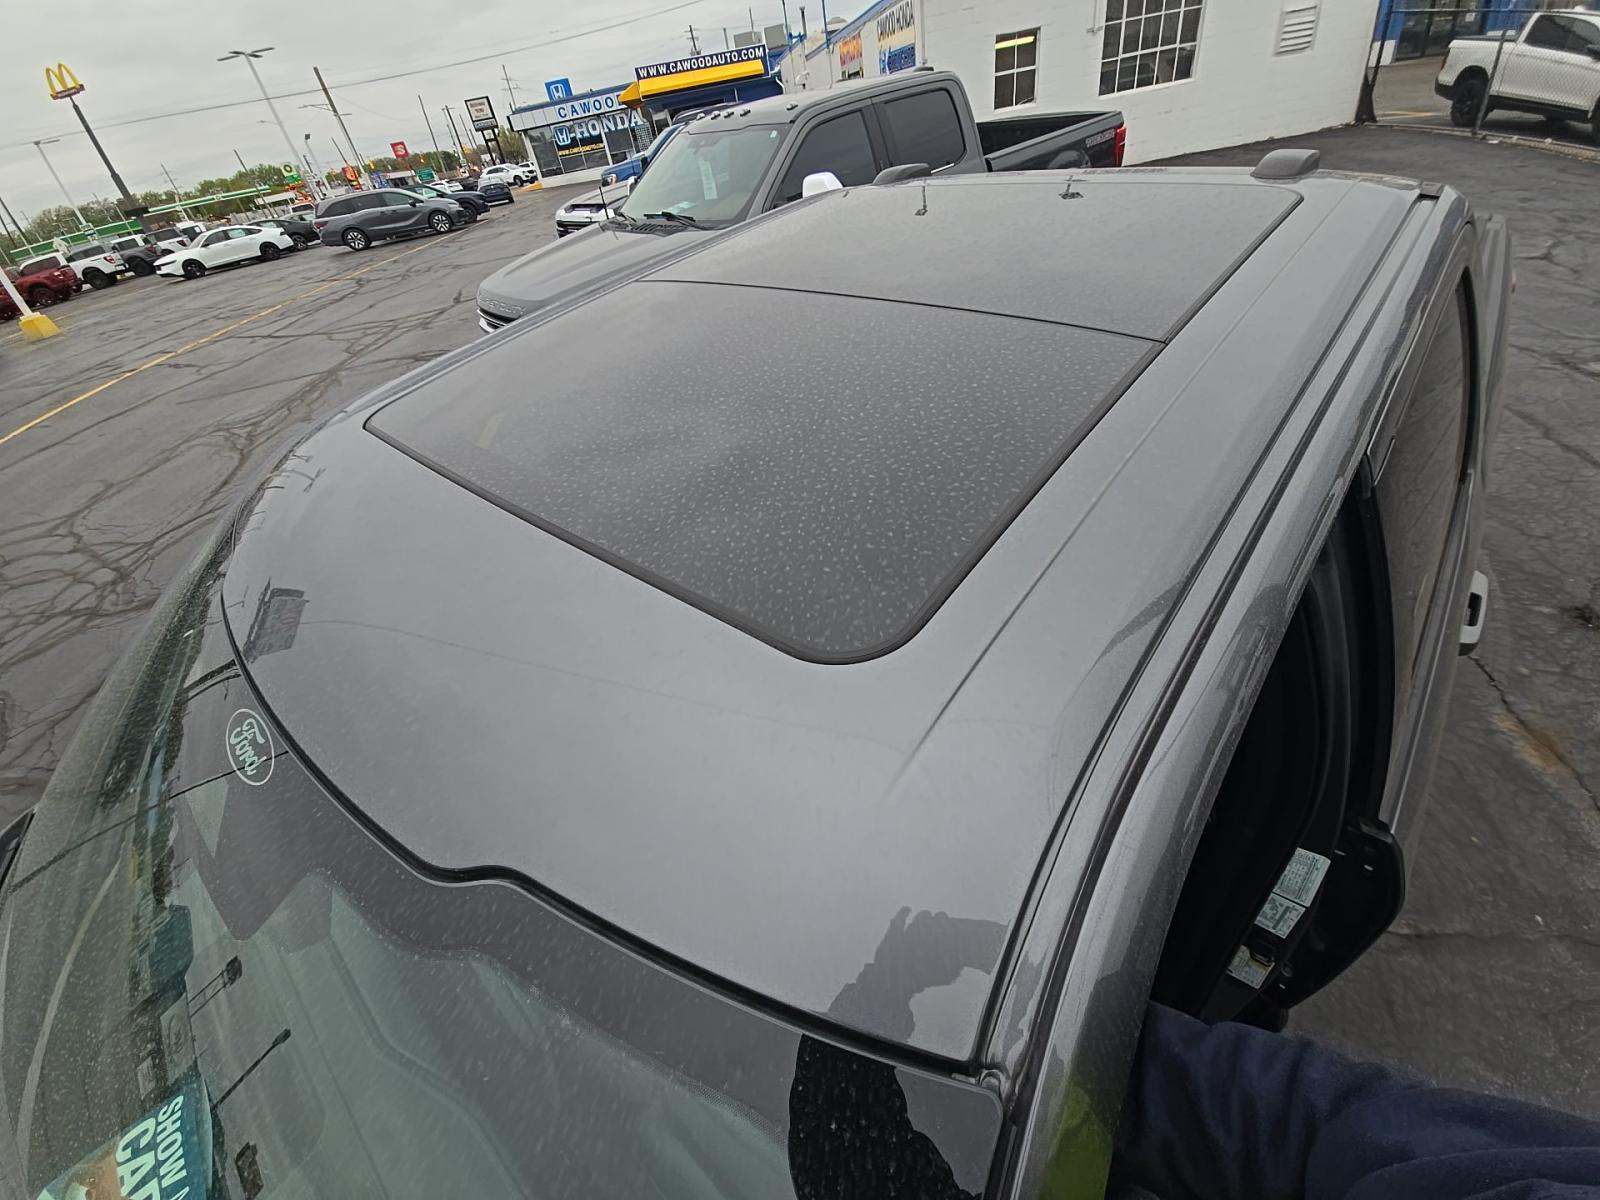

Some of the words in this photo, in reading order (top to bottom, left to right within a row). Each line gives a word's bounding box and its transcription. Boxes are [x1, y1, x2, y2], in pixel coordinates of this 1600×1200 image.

[637, 47, 764, 78] WWW.CAWOODAUTO.COM
[575, 109, 645, 139] HONDA
[230, 718, 266, 776] Ford
[157, 1095, 187, 1188] SHOW
